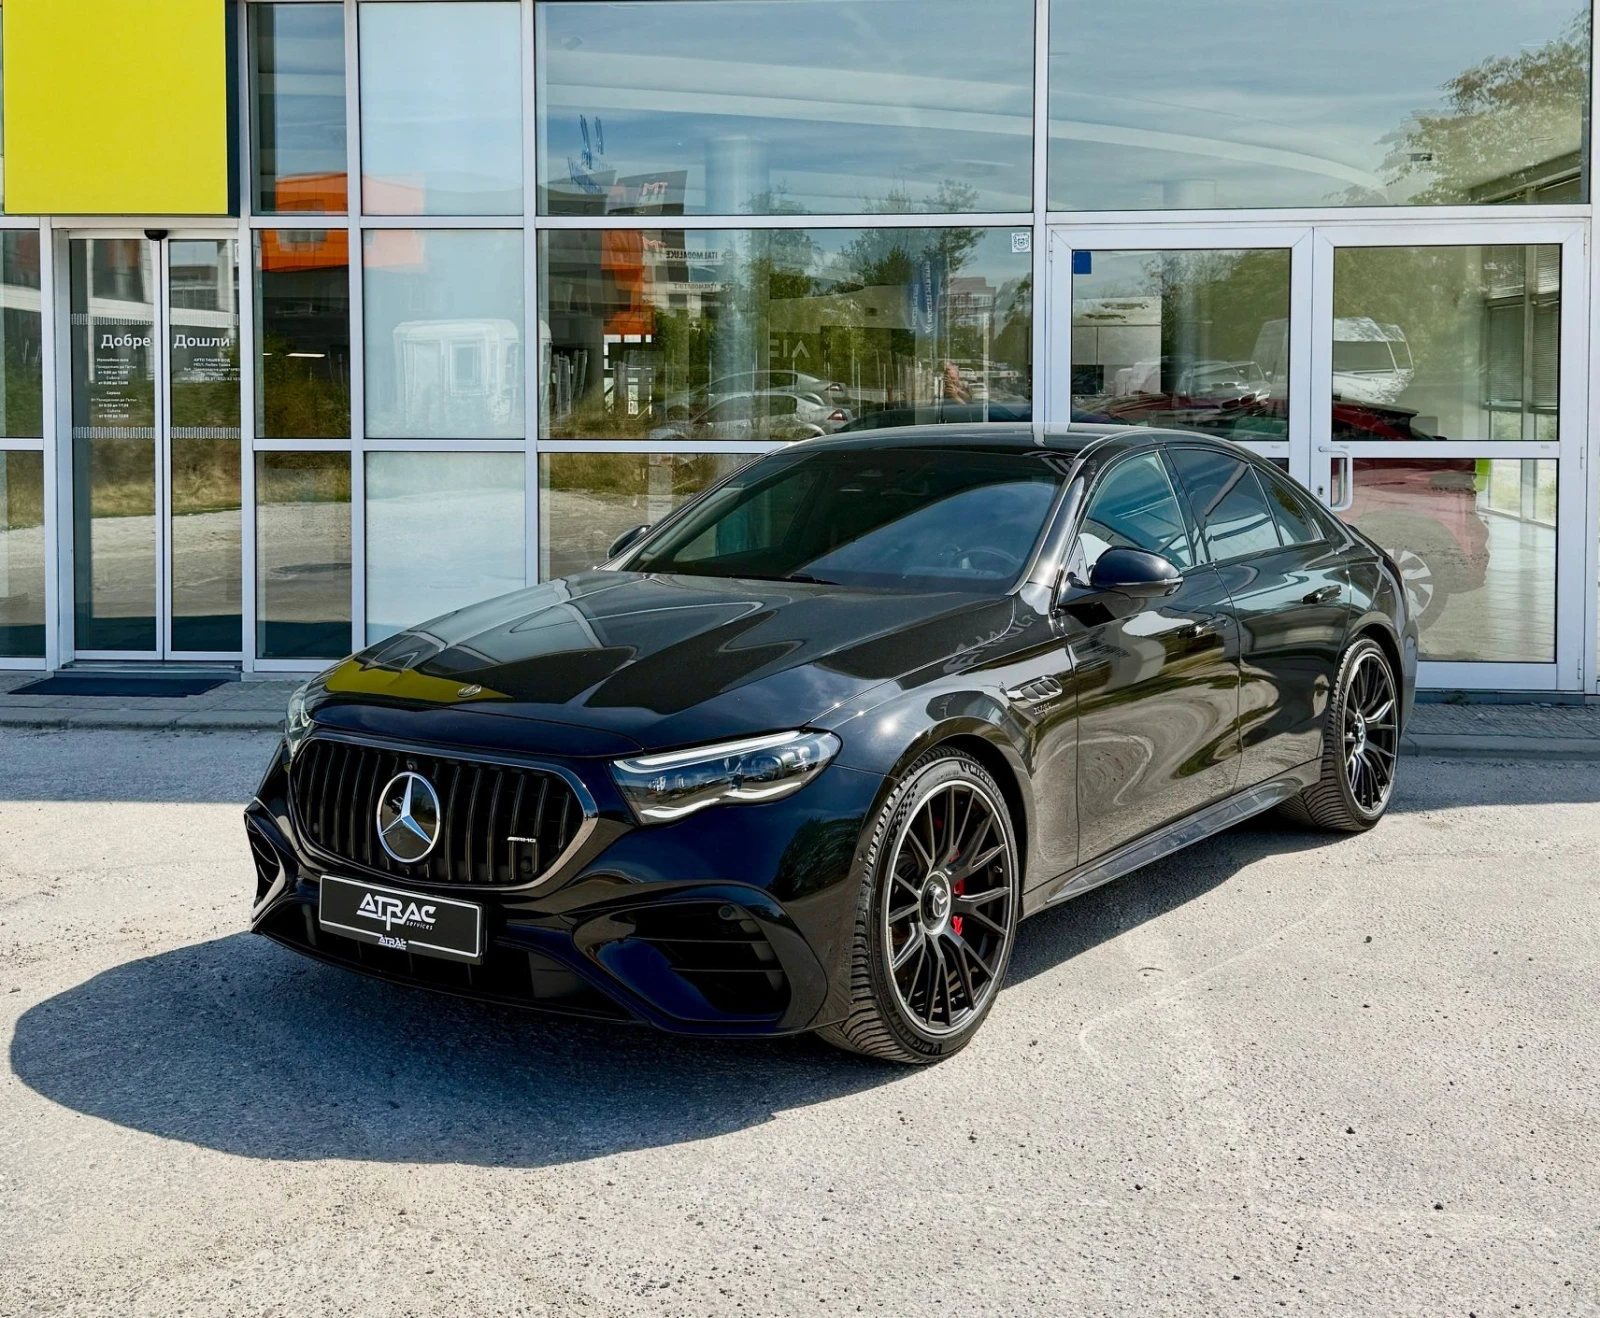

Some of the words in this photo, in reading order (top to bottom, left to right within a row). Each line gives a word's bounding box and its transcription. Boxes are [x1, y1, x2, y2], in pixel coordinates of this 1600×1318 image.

[101, 333, 151, 350] Добре
[174, 334, 230, 349] Дошли
[356, 892, 437, 932] ATRAC
[405, 920, 434, 931] services
